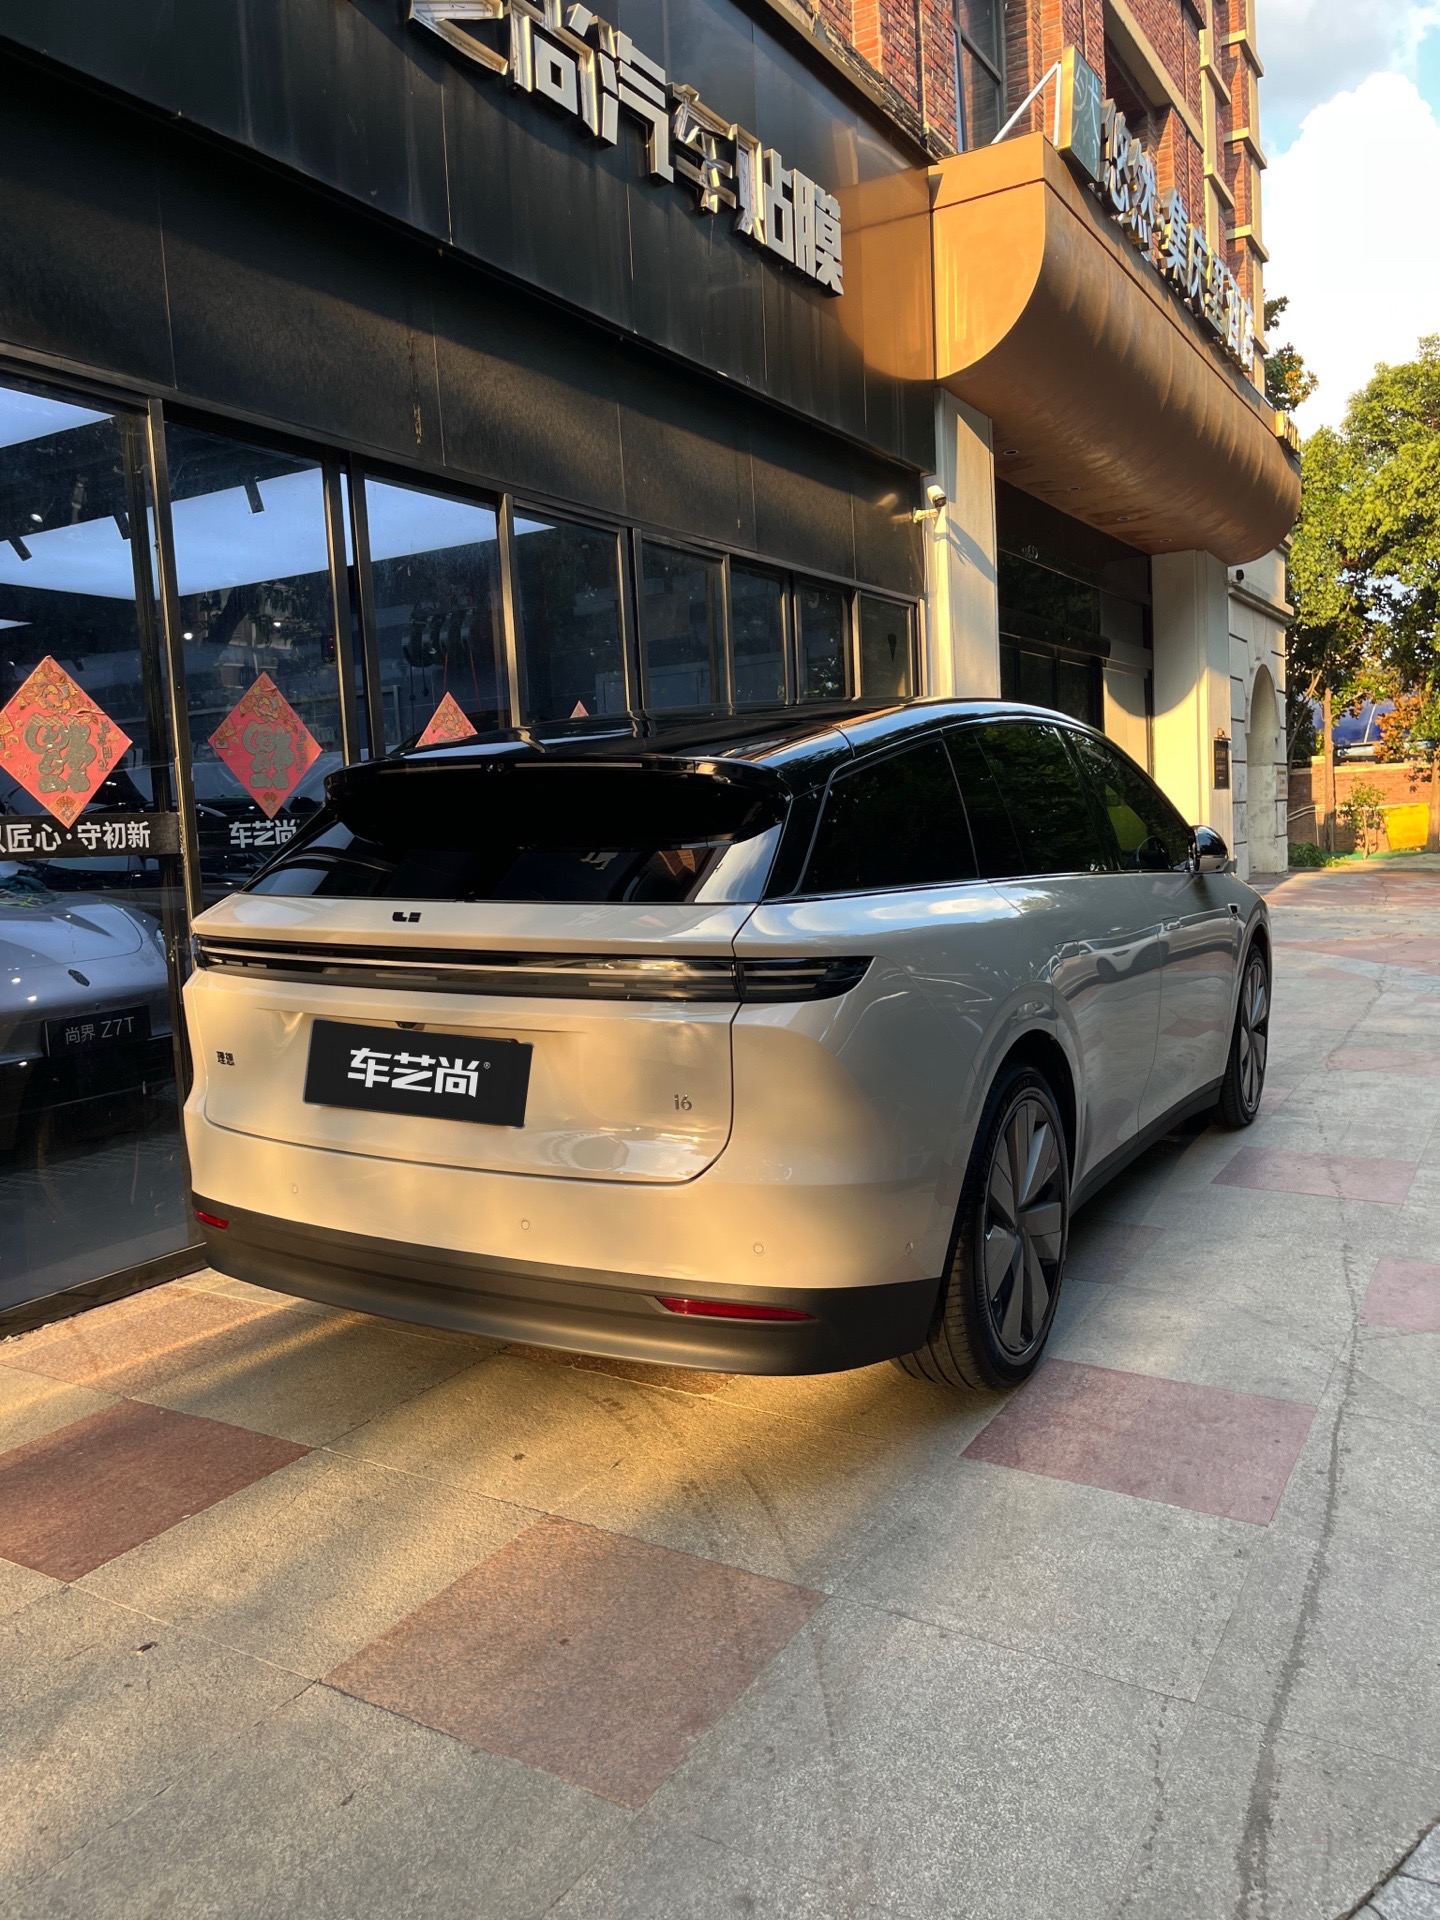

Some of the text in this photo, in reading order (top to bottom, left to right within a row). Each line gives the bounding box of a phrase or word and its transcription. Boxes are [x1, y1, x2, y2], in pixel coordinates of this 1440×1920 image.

[0, 820, 151, 853] 匠心·守初新
[228, 819, 297, 849] 车艺尚
[65, 1016, 135, 1045] 尚界 Z7T
[216, 1050, 235, 1066] 理想
[674, 1093, 693, 1111] i6
